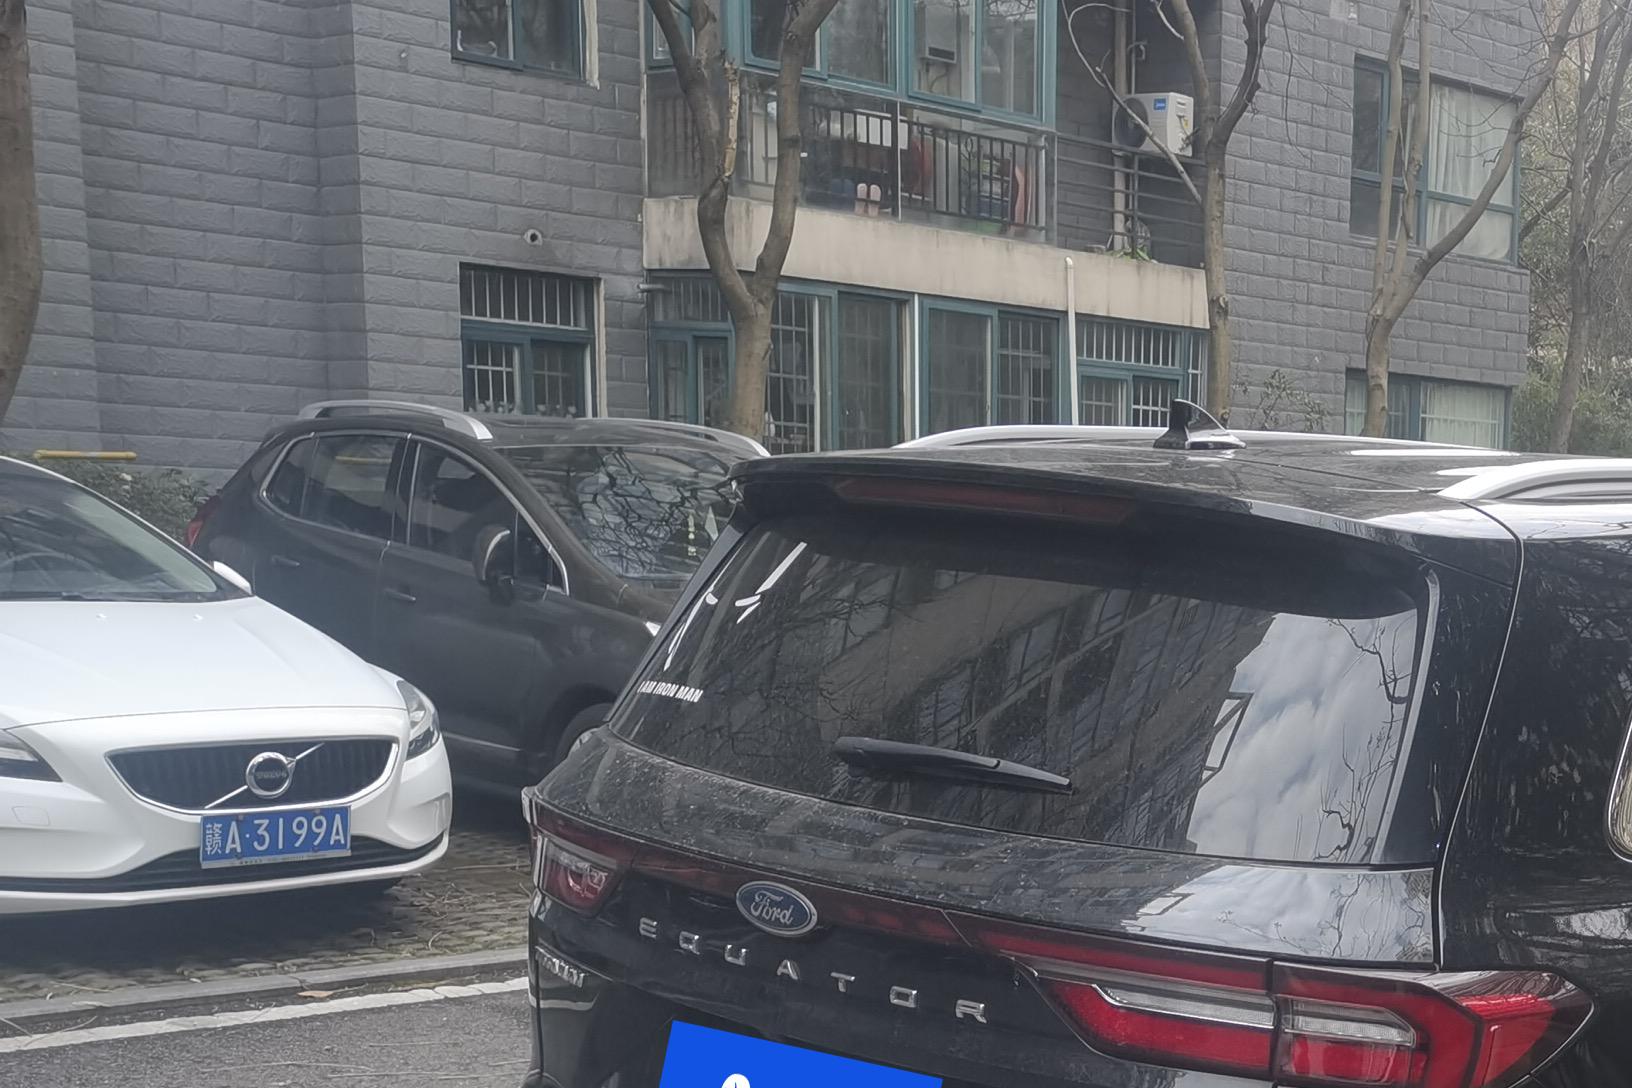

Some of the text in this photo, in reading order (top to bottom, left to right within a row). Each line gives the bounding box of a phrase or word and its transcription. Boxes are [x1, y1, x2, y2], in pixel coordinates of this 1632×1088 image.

[653, 682, 679, 698] IRON
[675, 686, 703, 702] MAN
[750, 890, 794, 925] Ford
[639, 917, 987, 1023] EQUATOR
